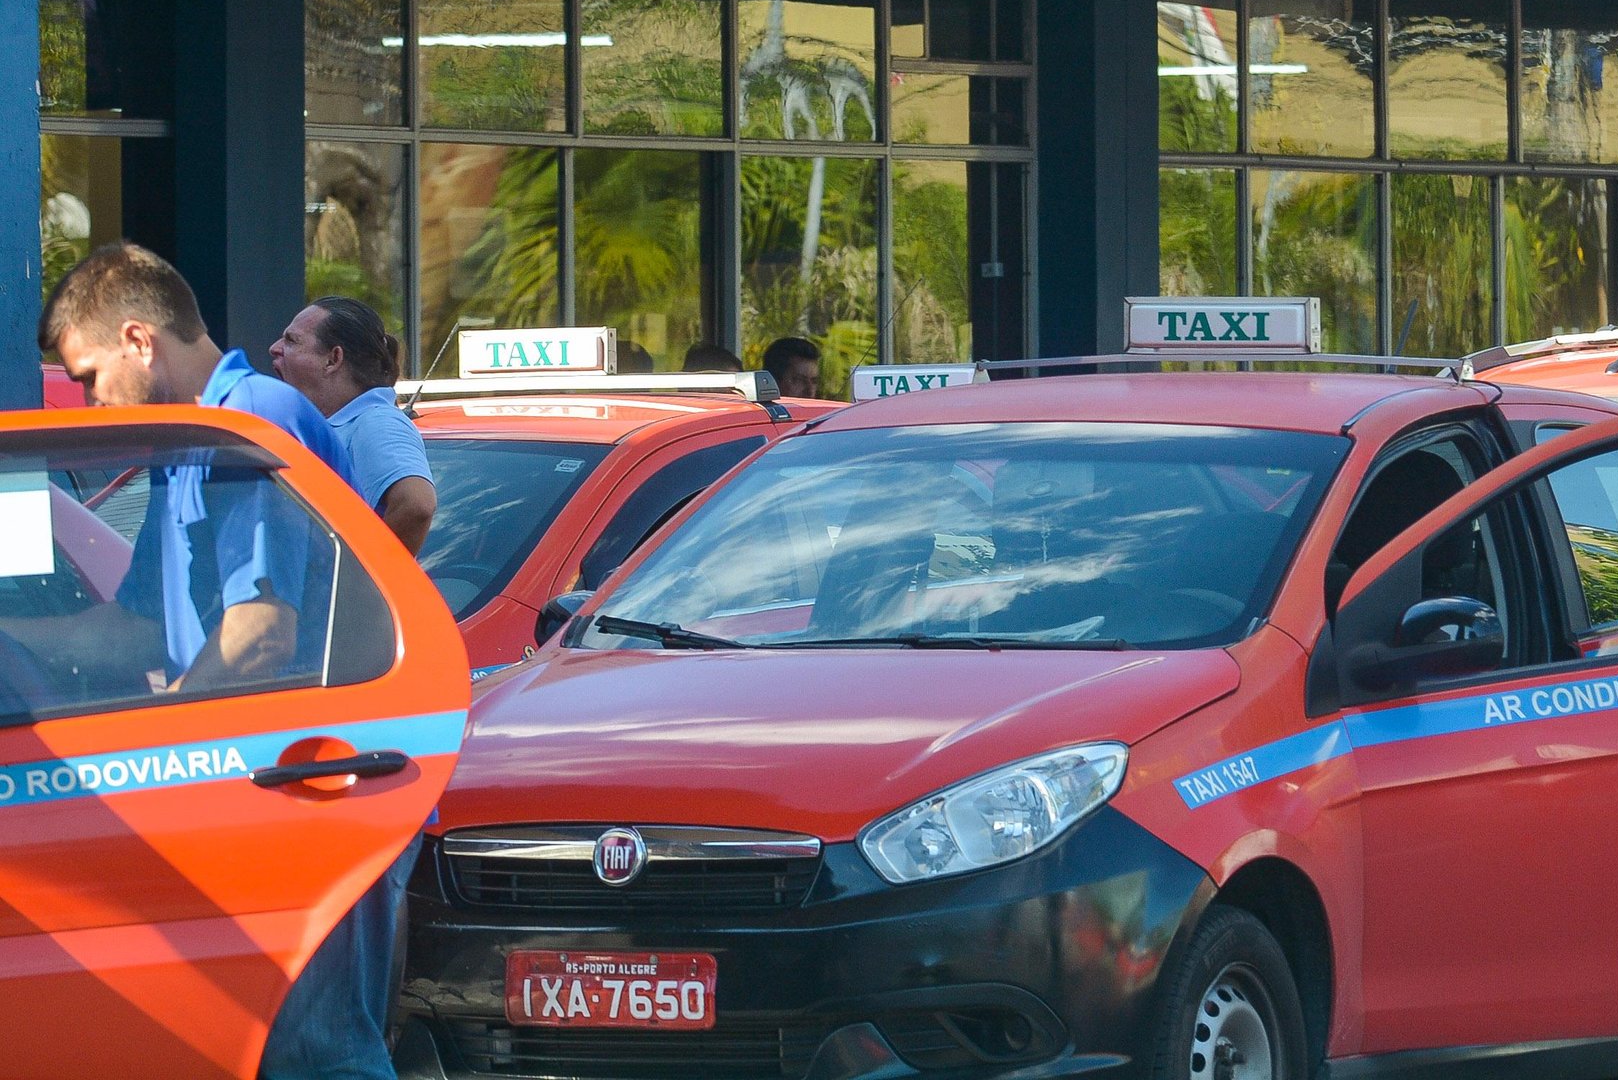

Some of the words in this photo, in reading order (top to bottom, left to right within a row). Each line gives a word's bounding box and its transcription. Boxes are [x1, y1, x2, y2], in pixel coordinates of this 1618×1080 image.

[1157, 311, 1270, 341] TAXI
[486, 340, 570, 367] TAXI
[1484, 695, 1525, 724] AR
[26, 746, 248, 797] RODOVIÁRIA
[1180, 769, 1228, 803] TAXI
[1223, 756, 1260, 788] 1547
[603, 845, 632, 870] FIAT
[565, 962, 616, 975] RS-PORTO
[618, 962, 658, 976] ALEGRE
